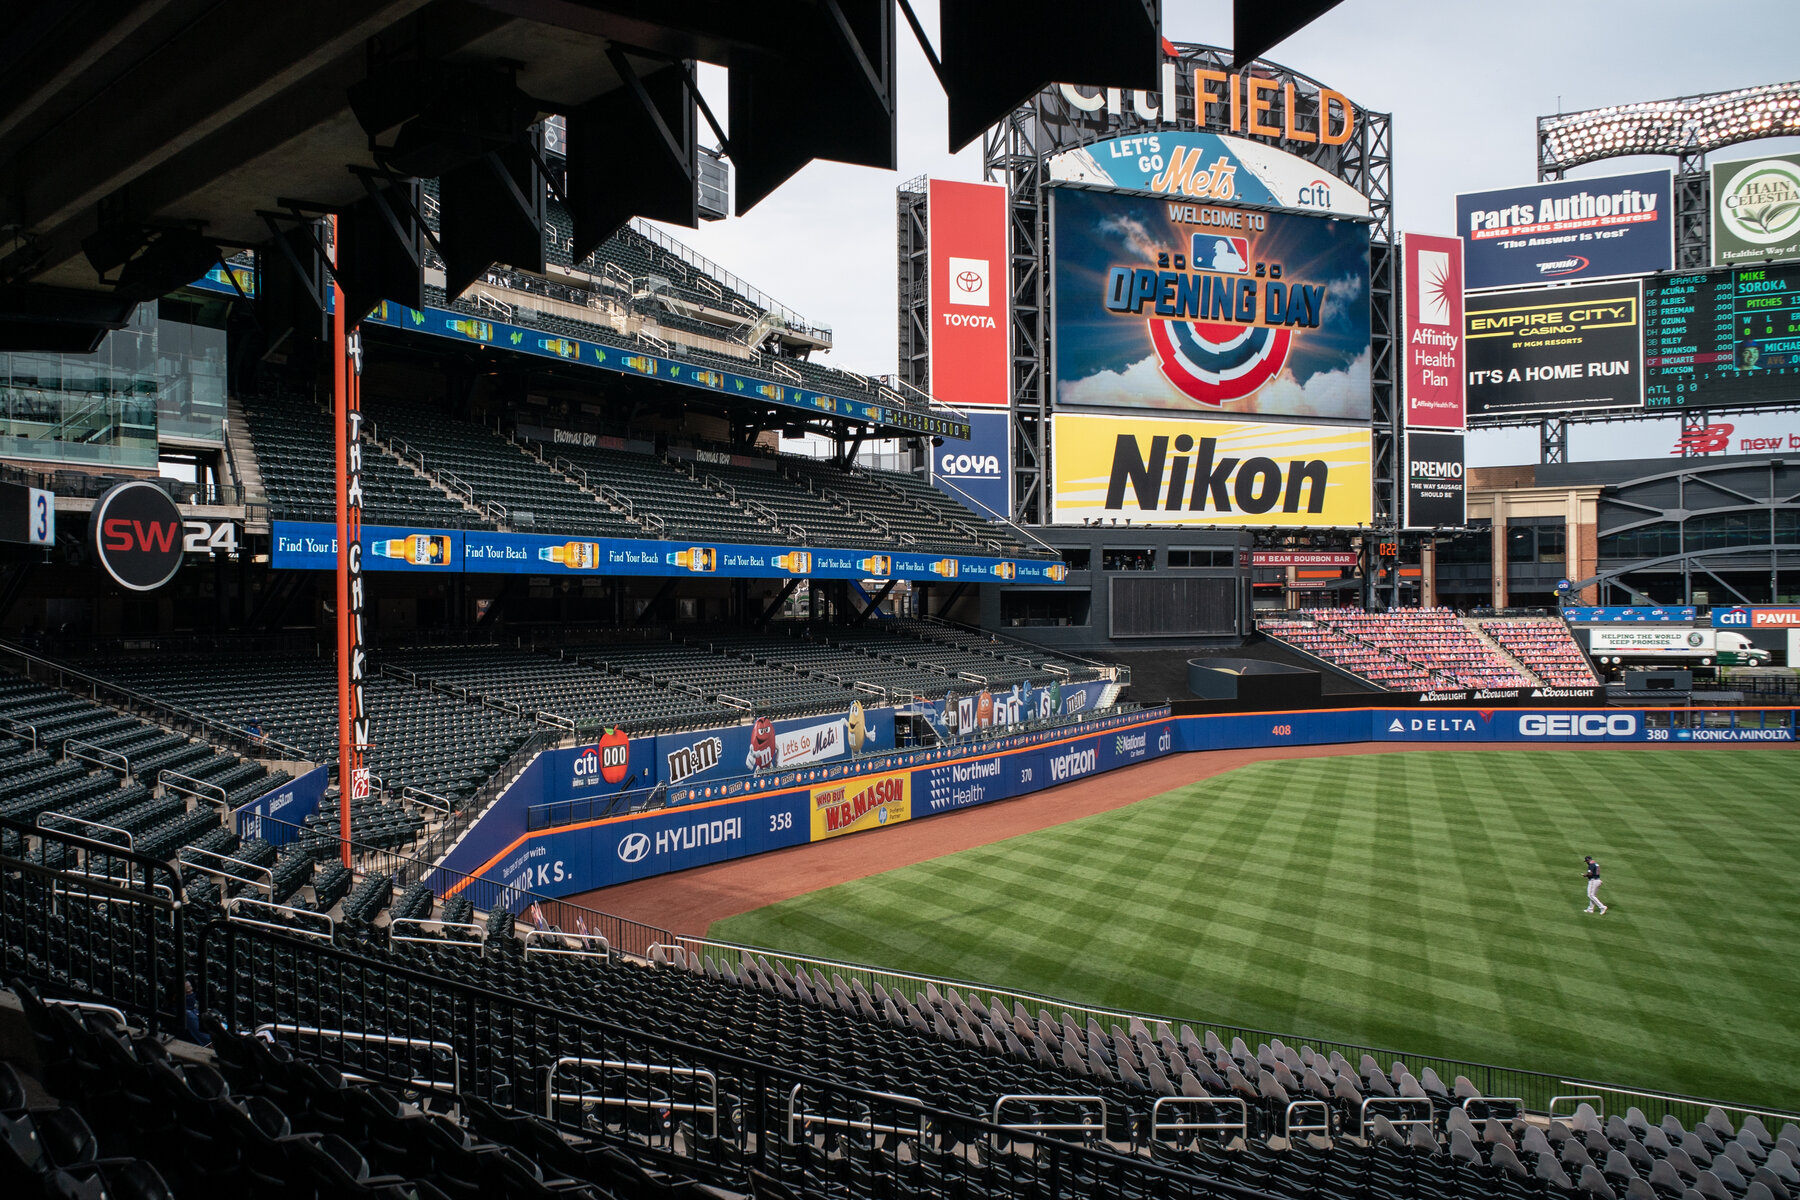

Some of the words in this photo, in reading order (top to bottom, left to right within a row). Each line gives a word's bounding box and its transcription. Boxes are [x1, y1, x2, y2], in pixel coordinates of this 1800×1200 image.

[1194, 68, 1354, 145] FIELD
[1110, 136, 1161, 158] LET'S
[1139, 154, 1164, 173] GO
[1151, 146, 1238, 201] Mets
[1299, 181, 1331, 208] citi
[1746, 181, 1790, 195] HAIN
[1168, 205, 1242, 228] WELCOME
[1246, 213, 1265, 230] TO
[1471, 204, 1534, 231] Parts
[1539, 190, 1658, 223] Authority
[1476, 229, 1510, 238] Auto
[1512, 225, 1551, 234] Parts
[1553, 219, 1599, 230] Super
[1601, 213, 1652, 225] Stores
[1528, 235, 1578, 246] Answer
[1580, 233, 1593, 241] Is
[1723, 249, 1765, 259] Healthier
[1766, 247, 1785, 256] Way
[1670, 275, 1708, 285] BRAVES
[1740, 271, 1766, 281] MIKE
[1714, 283, 1732, 291] .000
[1739, 280, 1787, 293] SOROKA
[1107, 267, 1258, 322] OPENING
[1265, 281, 1326, 328] DAY
[1661, 297, 1686, 305] ALBIES
[1747, 297, 1782, 308] PITCHES
[1661, 306, 1695, 315] FREEMAN
[943, 314, 996, 328] TOYOTA
[1471, 312, 1563, 330] EMPIRE
[1661, 317, 1686, 325] OZUNA
[1743, 316, 1752, 324] W
[1519, 325, 1576, 336] CASINO
[1661, 326, 1687, 335] ADAMS
[1412, 329, 1458, 351] Affinity
[1524, 340, 1543, 348] MGM
[1545, 337, 1583, 346] RESORTS
[1661, 337, 1682, 345] RILEY
[1714, 333, 1732, 341] .000
[1661, 345, 1697, 355] SWANSON
[1714, 343, 1732, 351] .000
[1415, 350, 1455, 367] Health
[1661, 356, 1695, 365] INCIARTE
[1469, 370, 1504, 385] IT'S
[1507, 368, 1521, 382] A
[1526, 363, 1584, 381] HOME
[1588, 360, 1630, 377] RUN
[1661, 366, 1694, 375] JACKSON
[1423, 370, 1448, 387] Plan
[1647, 385, 1670, 394] ATL
[1647, 396, 1670, 406] NYM
[1740, 437, 1783, 450] new
[942, 454, 1000, 475] GOYA
[1411, 461, 1463, 478] PREMIO
[1105, 433, 1328, 514] Nikon
[37, 495, 48, 542] 3
[104, 518, 178, 553] SW
[183, 521, 238, 552] 24
[278, 537, 302, 552] Find
[305, 538, 330, 553] Your
[465, 545, 484, 558] Find
[486, 545, 505, 558] Your
[506, 546, 527, 560] Beach
[609, 551, 624, 563] Find
[625, 551, 640, 563] Your
[641, 552, 658, 563] Beach
[724, 555, 736, 565] Find
[737, 555, 749, 566] Your
[750, 556, 764, 566] Beach
[1720, 611, 1747, 624] citi
[349, 544, 369, 751] CHIKIN
[1428, 691, 1449, 702] Coors
[1449, 692, 1467, 700] LIGHT
[1480, 690, 1500, 699] Coors
[1500, 690, 1519, 698] LIGHT
[1542, 687, 1570, 697] Coors
[1570, 689, 1594, 697] LIGHT
[1272, 725, 1291, 735] 408
[1411, 719, 1476, 731] DELTA
[1519, 714, 1636, 736] GEICO
[1123, 732, 1146, 751] National
[1159, 730, 1171, 752] citi
[1646, 730, 1669, 740] 380
[1692, 730, 1738, 740] KONICA
[1739, 730, 1791, 740] MINOLTA
[782, 740, 799, 756] Let's
[800, 735, 811, 748] Go
[604, 746, 626, 766] 000
[1050, 747, 1095, 780] verizon
[574, 753, 597, 775] citi
[953, 758, 1000, 783] Northwell
[1021, 768, 1032, 783] 370
[816, 793, 831, 807] WHO
[832, 788, 845, 801] BUT
[953, 783, 983, 805] Health
[770, 812, 792, 832] 358
[656, 817, 741, 855] HYUNDAI
[530, 846, 546, 857] with
